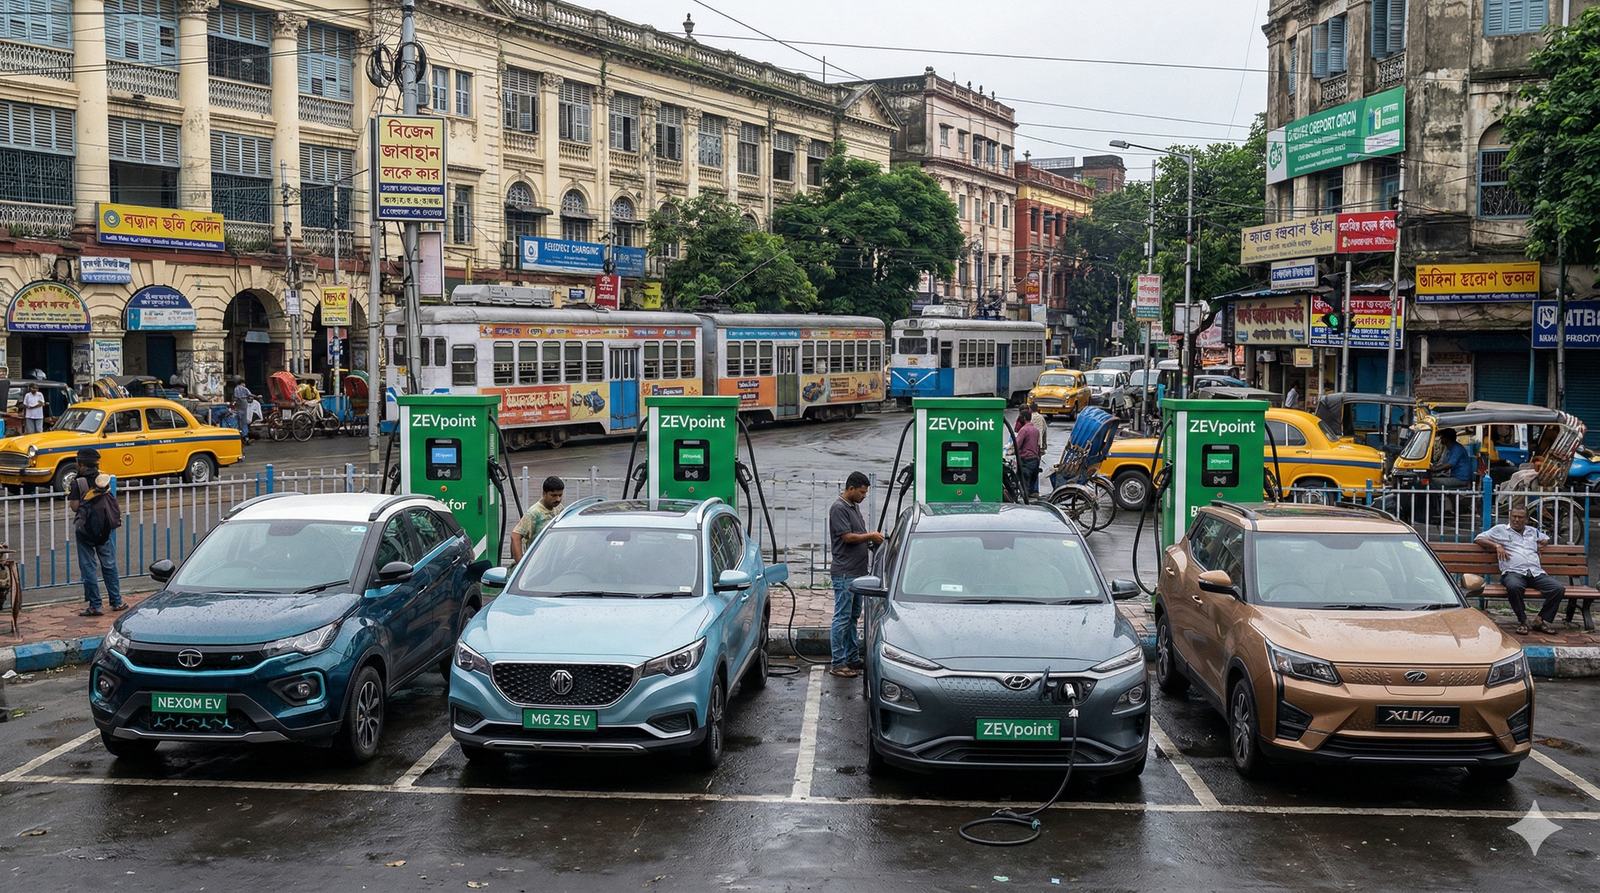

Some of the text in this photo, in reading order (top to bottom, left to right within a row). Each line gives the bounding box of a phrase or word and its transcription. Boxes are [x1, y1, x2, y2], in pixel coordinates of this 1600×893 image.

[387, 119, 434, 139] বিজেন
[380, 144, 440, 163] জাবাহান
[381, 166, 440, 180] লকে কার
[412, 413, 477, 430] ZEVpoint
[660, 414, 726, 431] ZEVpoint
[928, 417, 995, 434] ZEVpoint
[1189, 419, 1256, 436] ZEVpoint
[551, 671, 572, 694] MG
[158, 696, 222, 710] NEXOM EV
[531, 713, 591, 727] MG ZS EV
[983, 722, 1054, 738] ZEVpoint
